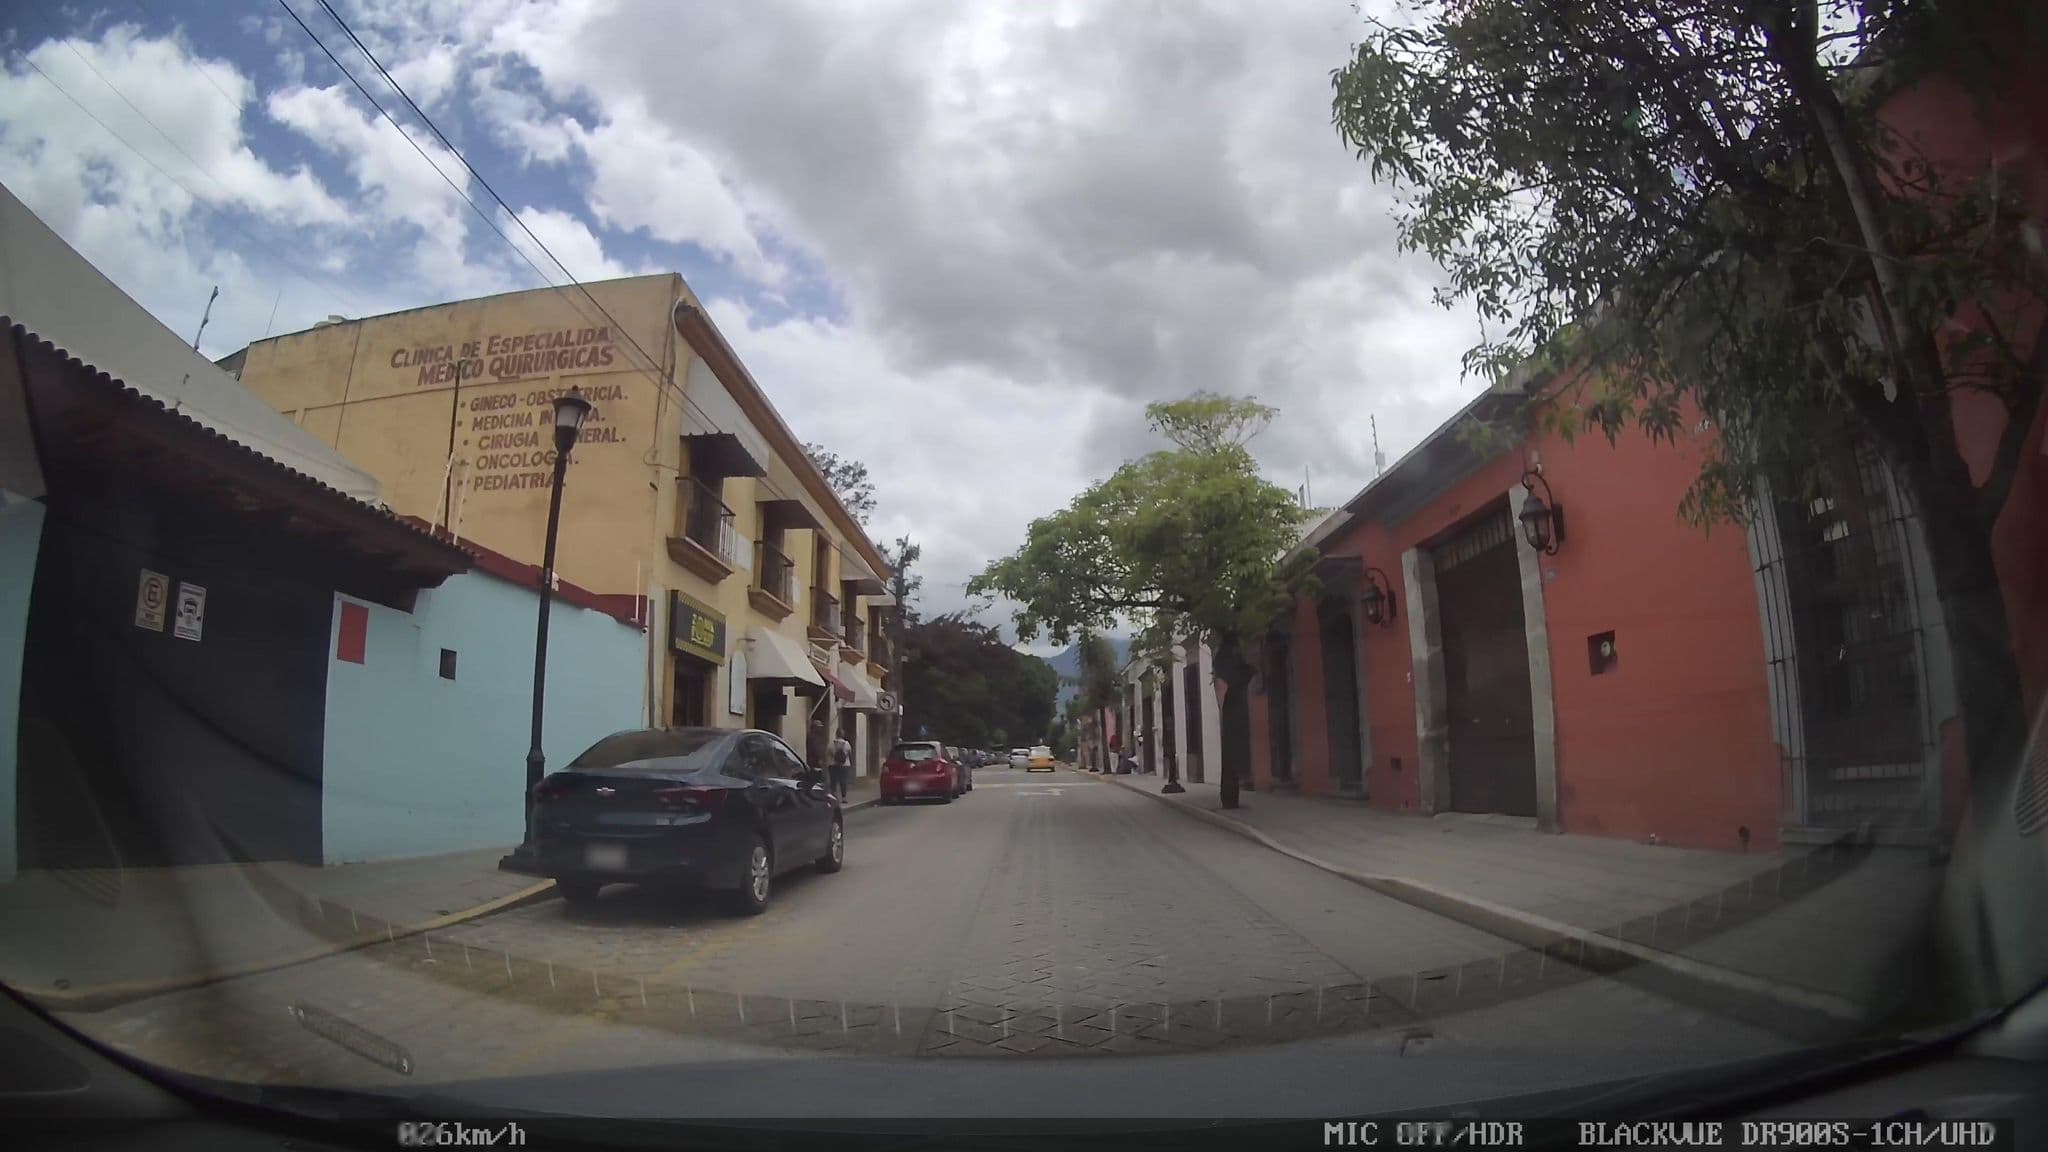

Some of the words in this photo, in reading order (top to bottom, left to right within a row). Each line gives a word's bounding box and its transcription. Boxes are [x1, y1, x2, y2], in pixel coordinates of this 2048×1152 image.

[391, 345, 453, 368] CLINICA
[460, 341, 481, 358] DE
[488, 345, 613, 382] QUIRURGICAS
[472, 412, 532, 431] MEDICINA
[478, 432, 539, 450] CIRUGIA
